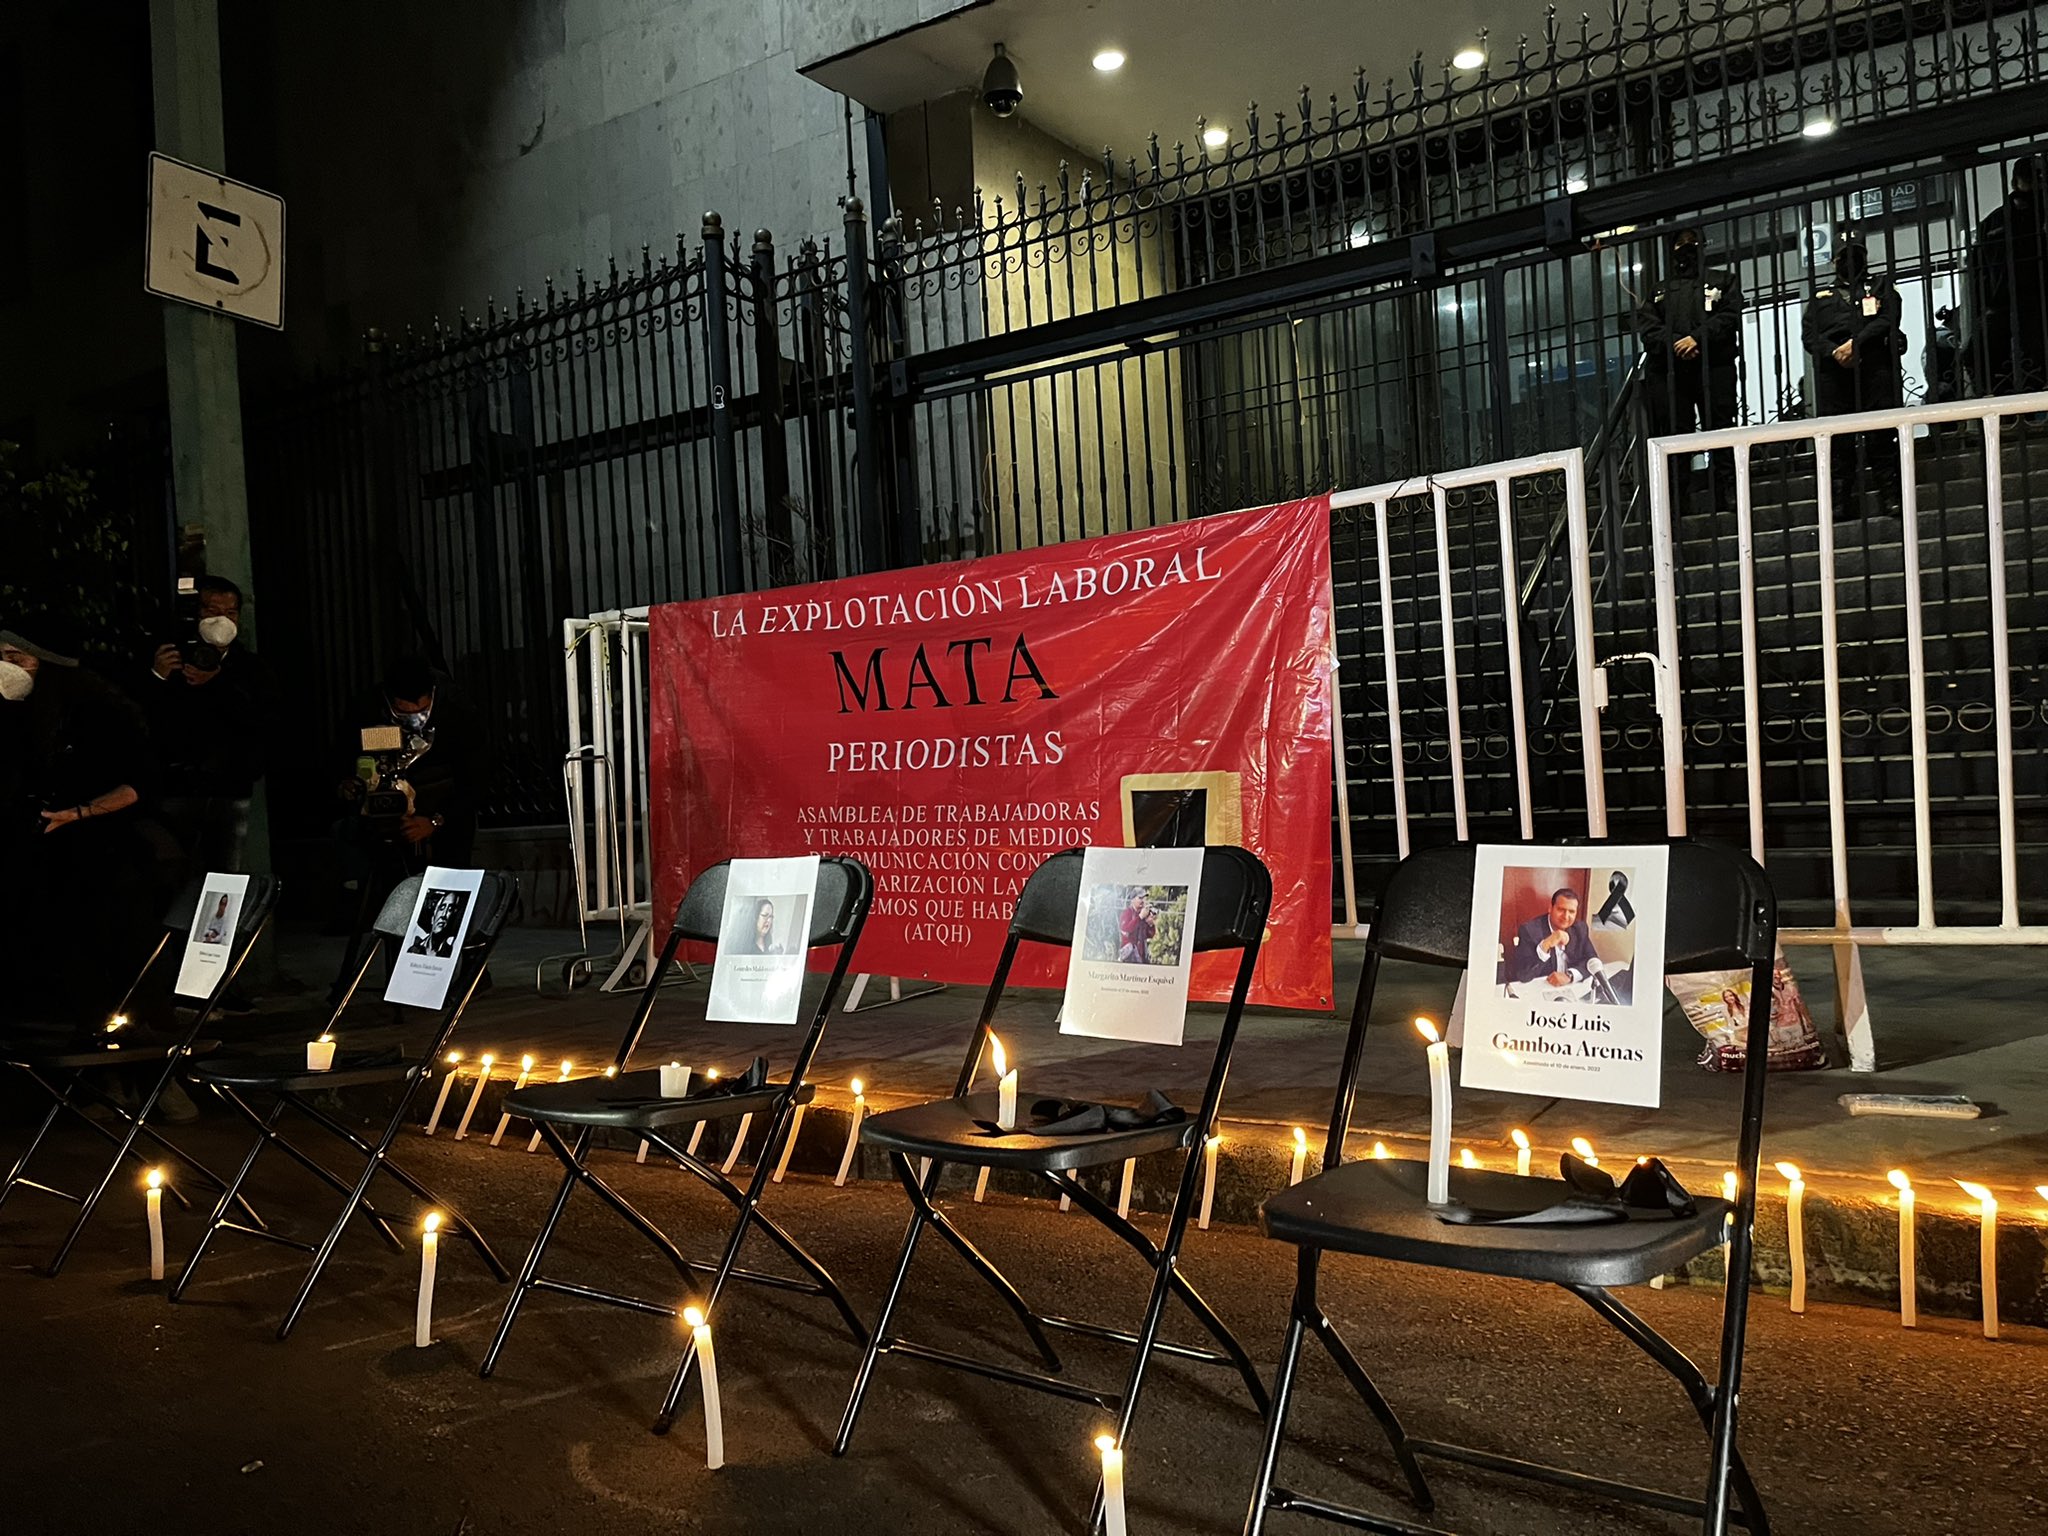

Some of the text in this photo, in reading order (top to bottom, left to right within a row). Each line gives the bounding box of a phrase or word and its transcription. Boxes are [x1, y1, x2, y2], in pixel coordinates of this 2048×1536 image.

[712, 546, 1223, 639] LA EXPLOTACIÓN LABORAL
[828, 632, 1060, 715] MATA
[828, 730, 1065, 773] PERIODISTAS
[796, 801, 1100, 824] ASAMBLEA DE TRABAJADORAS
[803, 827, 1093, 847] Y TRABAJADORES DE MEDIOS
[873, 871, 1029, 896] ARIZACIÓN LA
[925, 900, 964, 922] QUE
[972, 902, 1014, 921] HAB
[904, 923, 972, 947] (ATQH)
[1526, 1010, 1611, 1033] José Luis
[1492, 1032, 1643, 1062] Gamboa Arenas
